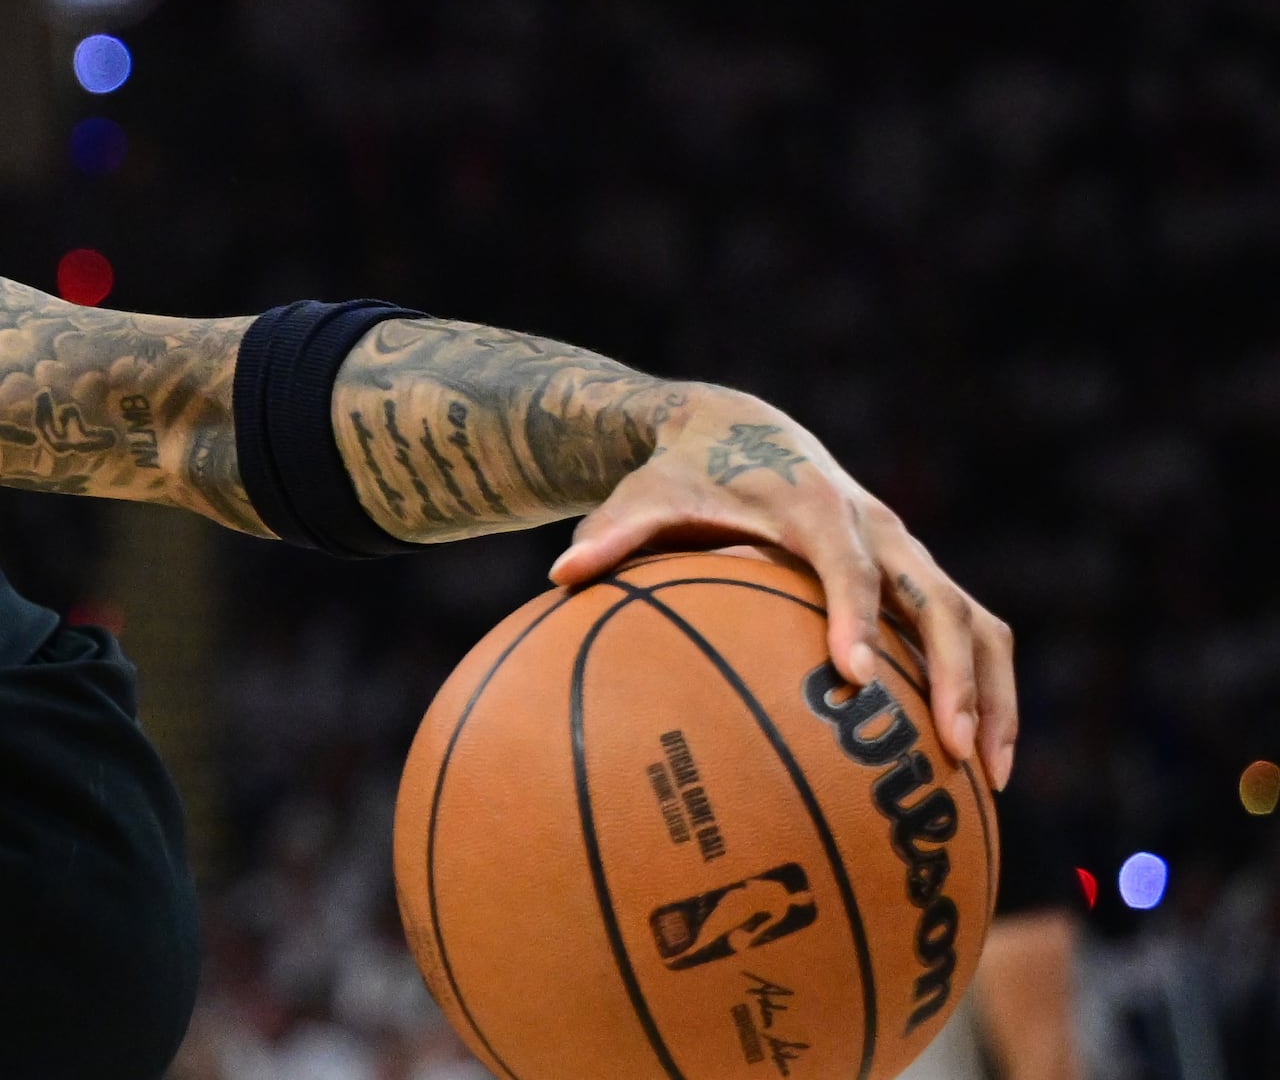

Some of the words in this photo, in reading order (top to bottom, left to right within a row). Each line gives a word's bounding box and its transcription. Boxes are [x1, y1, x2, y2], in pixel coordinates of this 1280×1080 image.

[682, 786, 716, 827] GAME
[697, 824, 727, 863] BALL
[801, 661, 959, 1038] Wilson
